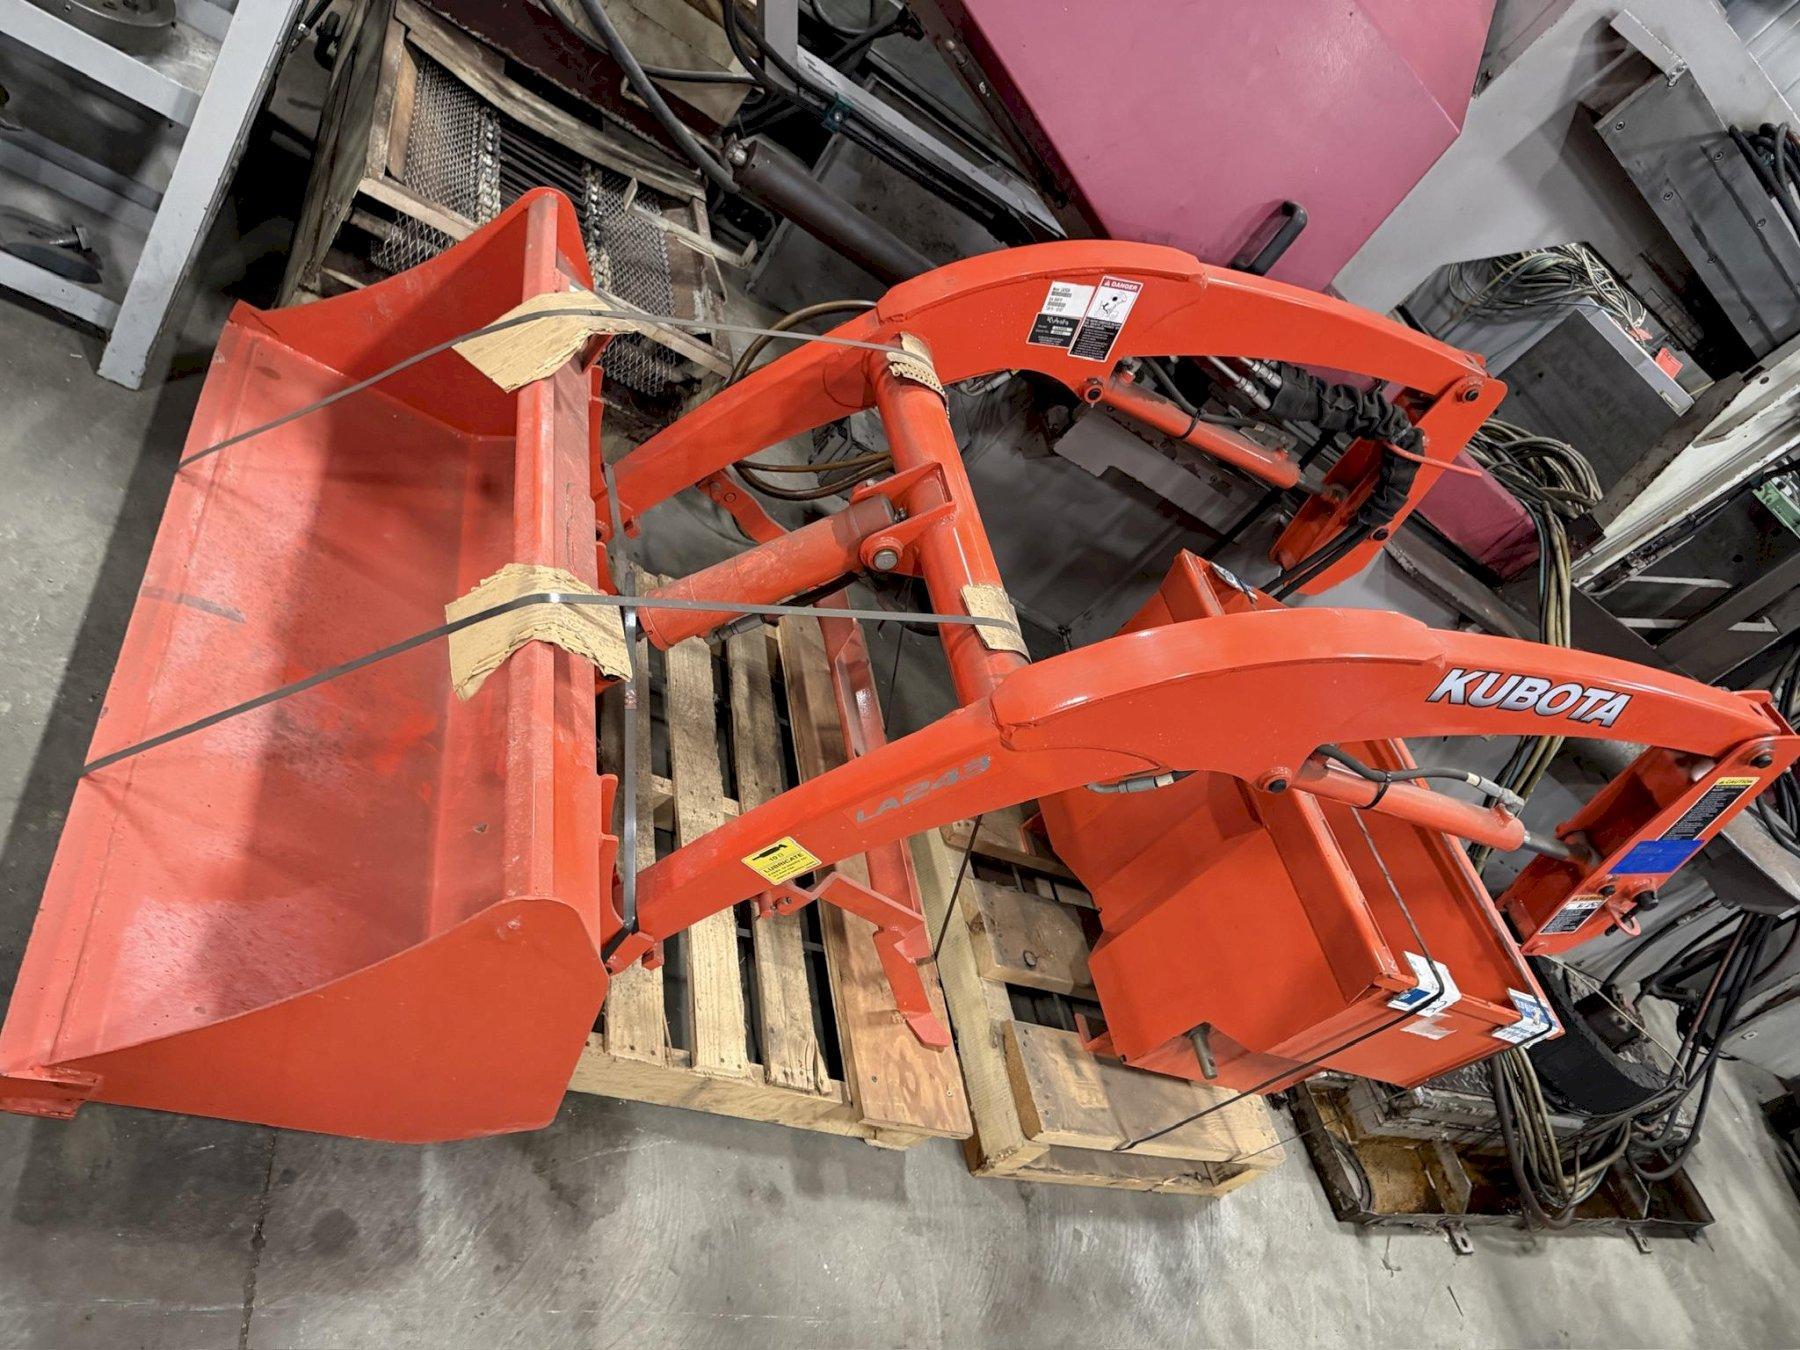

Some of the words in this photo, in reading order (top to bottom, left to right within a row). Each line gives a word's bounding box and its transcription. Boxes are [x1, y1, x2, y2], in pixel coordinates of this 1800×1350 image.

[1111, 279, 1138, 291] DANGER
[1425, 667, 1633, 728] KUBOTA
[856, 754, 992, 823] LA243
[763, 853, 803, 874] LUBRICATE
